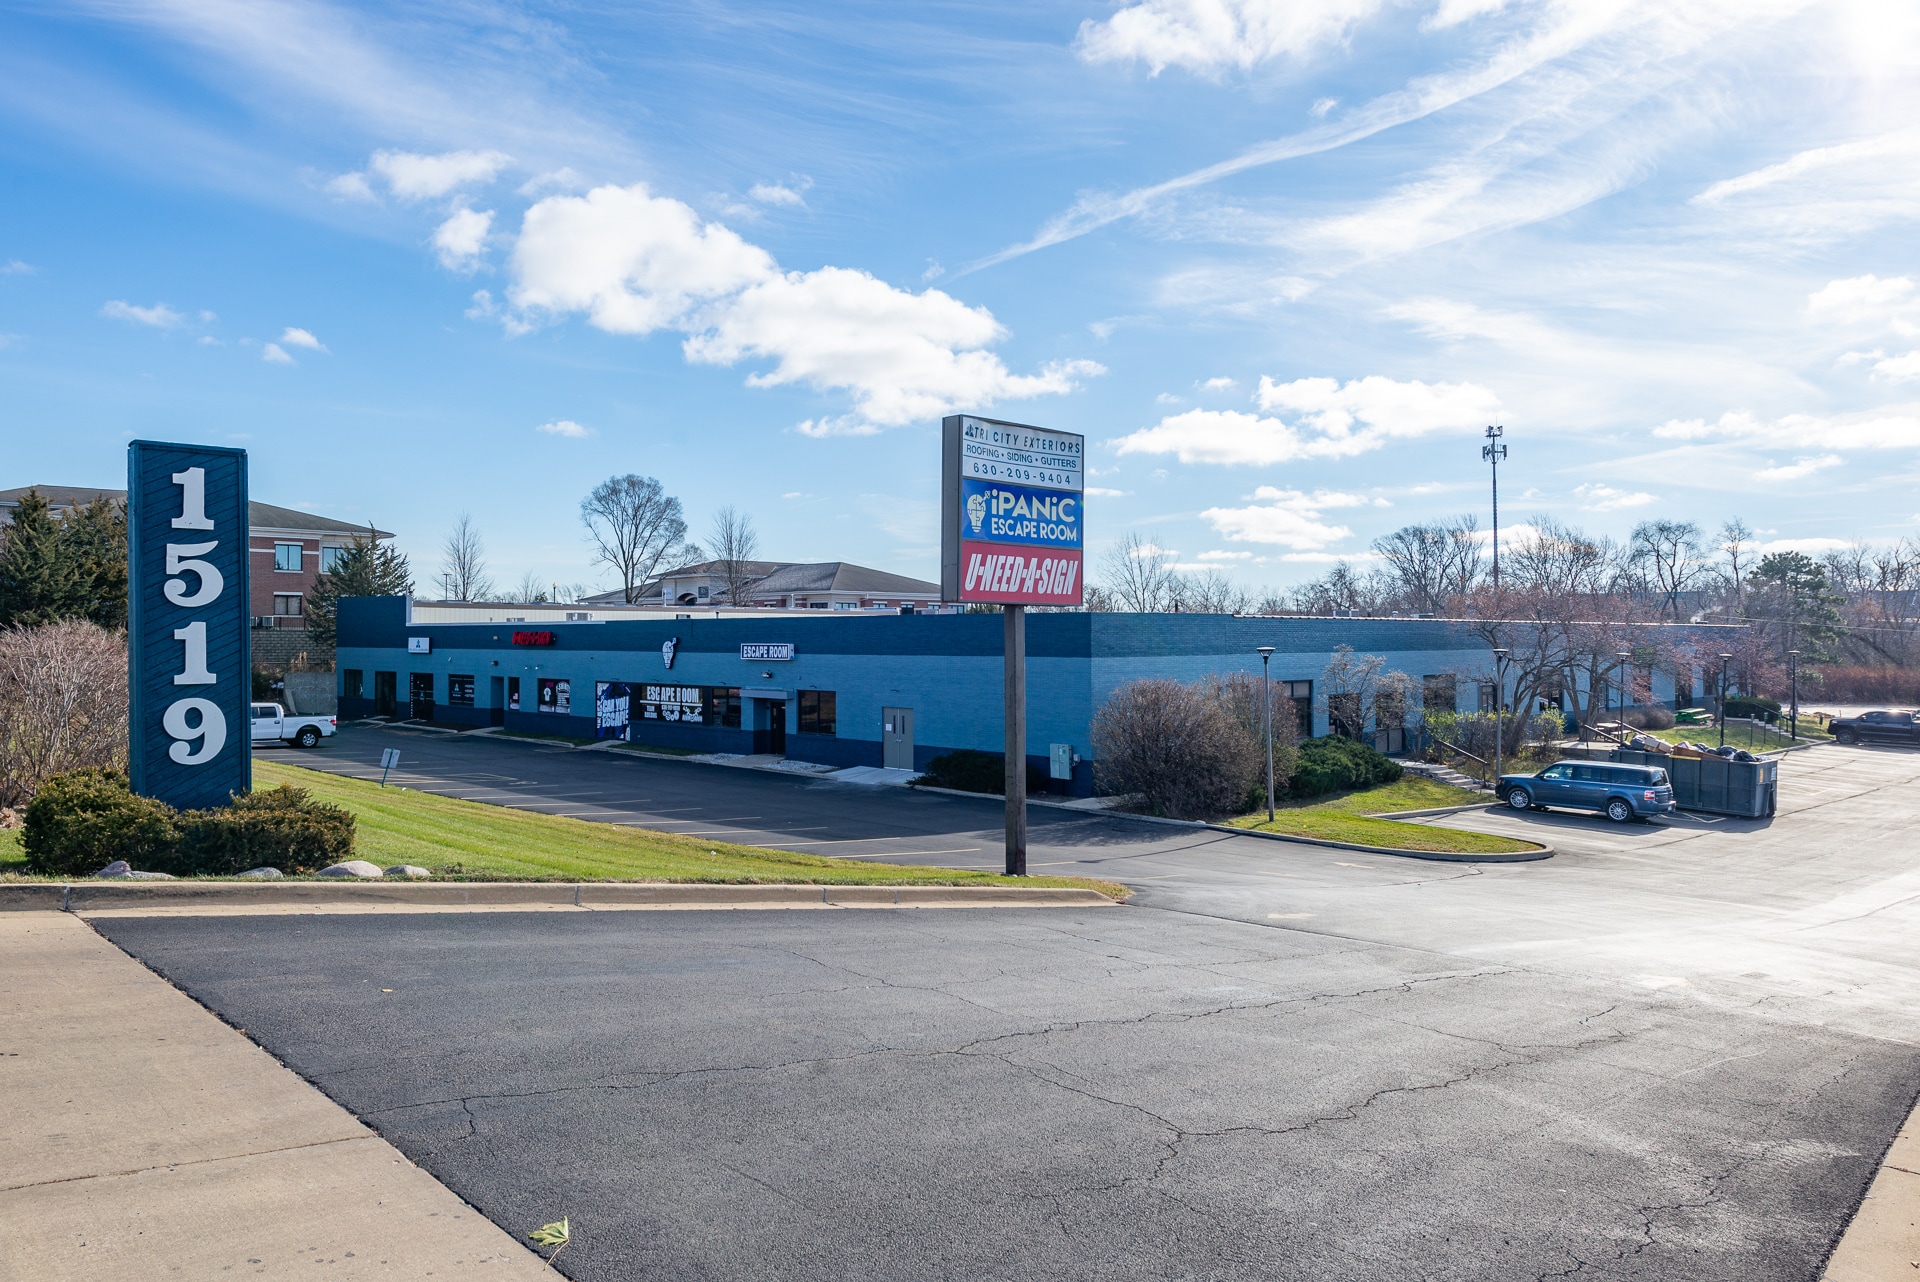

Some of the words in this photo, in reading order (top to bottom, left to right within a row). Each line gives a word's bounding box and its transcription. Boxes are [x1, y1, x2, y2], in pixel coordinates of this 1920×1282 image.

[974, 426, 989, 441] TRI
[993, 431, 1019, 446] CITY
[1023, 436, 1080, 454] EXTERIORS
[966, 444, 1000, 459] ROOFING
[1006, 451, 1033, 464] SIDING
[1041, 456, 1077, 469] GUTTERS
[973, 462, 1071, 485] 630-209-9404
[991, 518, 1037, 539] ESCAPE
[1039, 522, 1077, 542] ROOM
[964, 553, 1079, 595] U-NEED-A-SIGN
[163, 467, 227, 765] 1519
[743, 645, 768, 658] ESCAPE
[768, 646, 788, 659] ROOM
[615, 695, 629, 711] YOU
[646, 686, 675, 702] ESCAPE
[676, 687, 699, 703] ROOM
